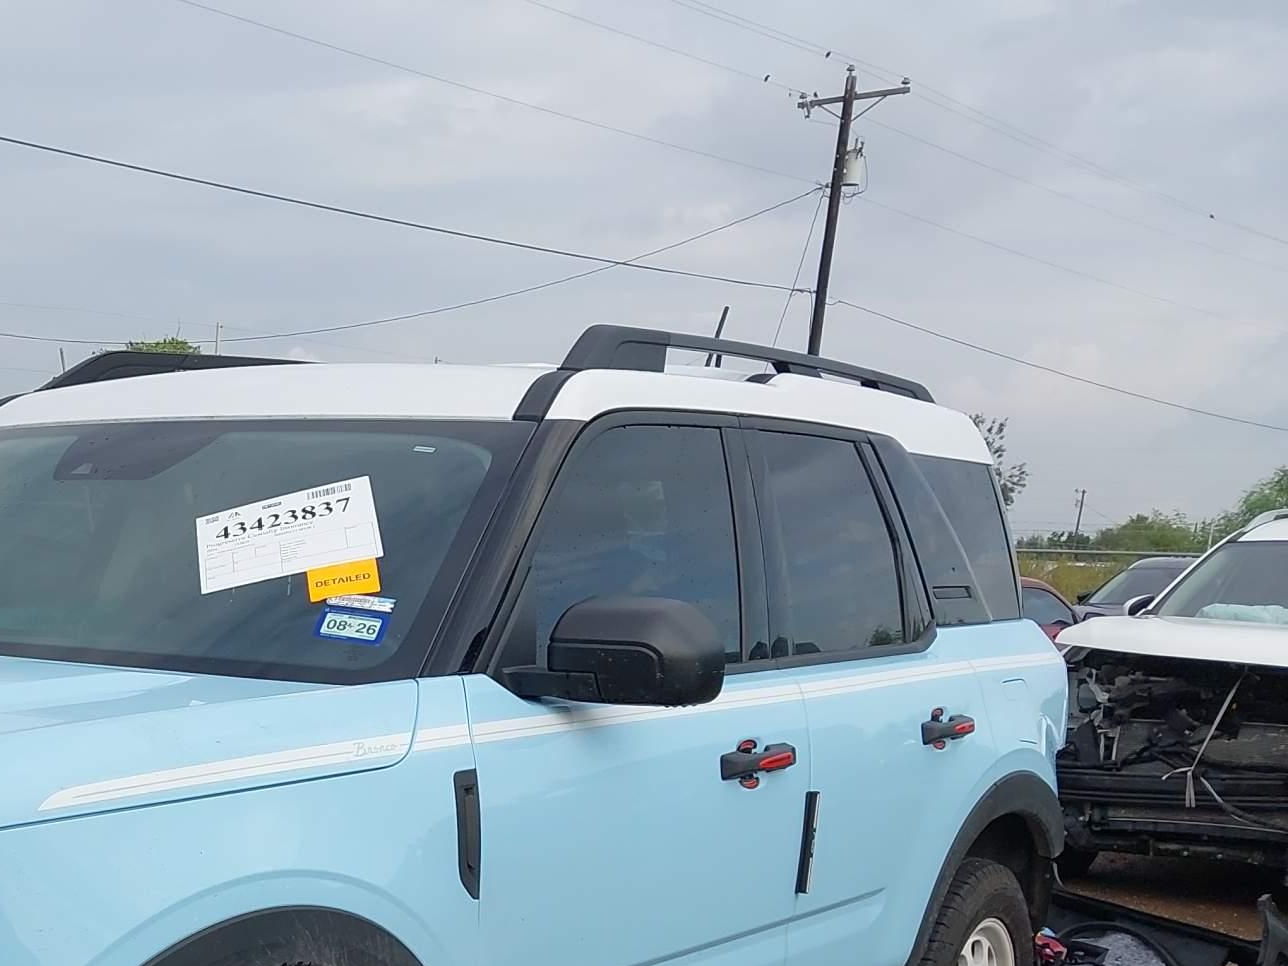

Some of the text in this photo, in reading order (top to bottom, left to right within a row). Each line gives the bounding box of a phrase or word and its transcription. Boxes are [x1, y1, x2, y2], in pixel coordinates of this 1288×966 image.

[215, 496, 351, 540] 43423837
[315, 572, 372, 588] DETAILED
[326, 618, 378, 636] 08 26
